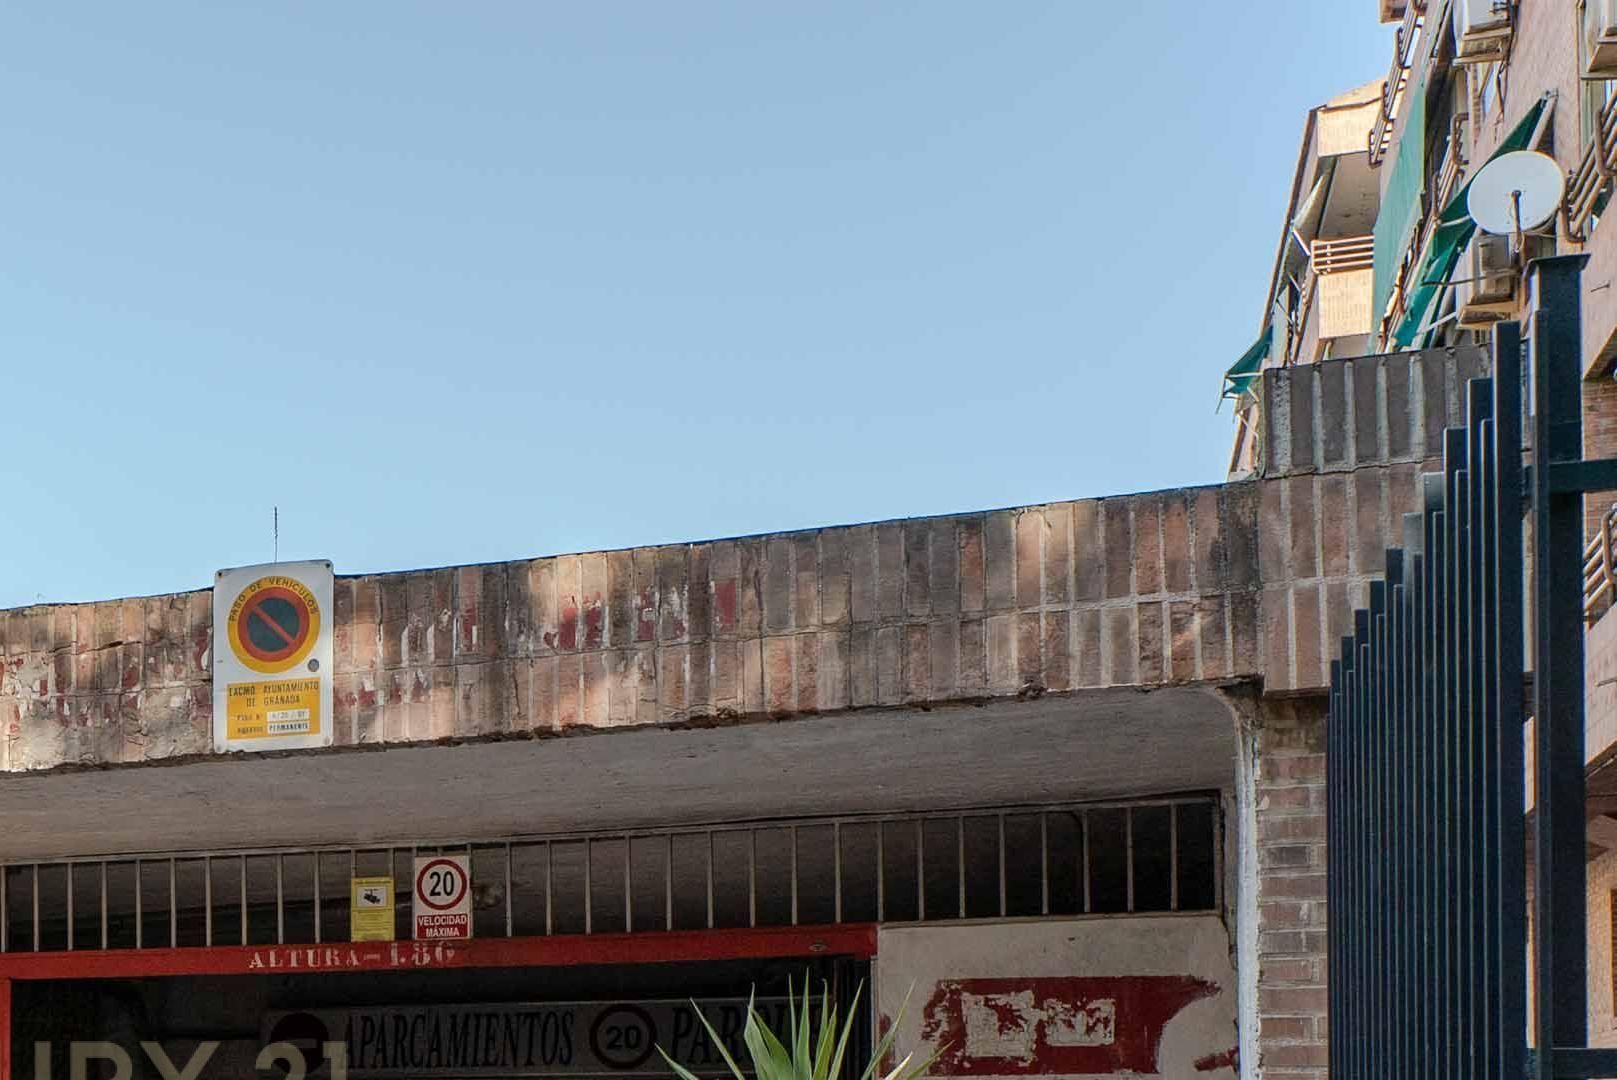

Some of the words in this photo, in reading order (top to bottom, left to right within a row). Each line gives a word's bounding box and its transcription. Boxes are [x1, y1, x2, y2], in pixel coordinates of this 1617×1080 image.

[229, 594, 246, 621] PASO
[249, 583, 263, 592] DE
[263, 680, 319, 694] AYUNTAMIENTO
[246, 698, 255, 707] DE
[263, 696, 300, 706] GRANADA
[429, 871, 454, 897] 20
[418, 915, 467, 926] VELOCIDAD
[426, 926, 460, 938] MÁXIMA
[345, 1010, 574, 1070] APARCAMIENTOS
[606, 1024, 641, 1052] 20
